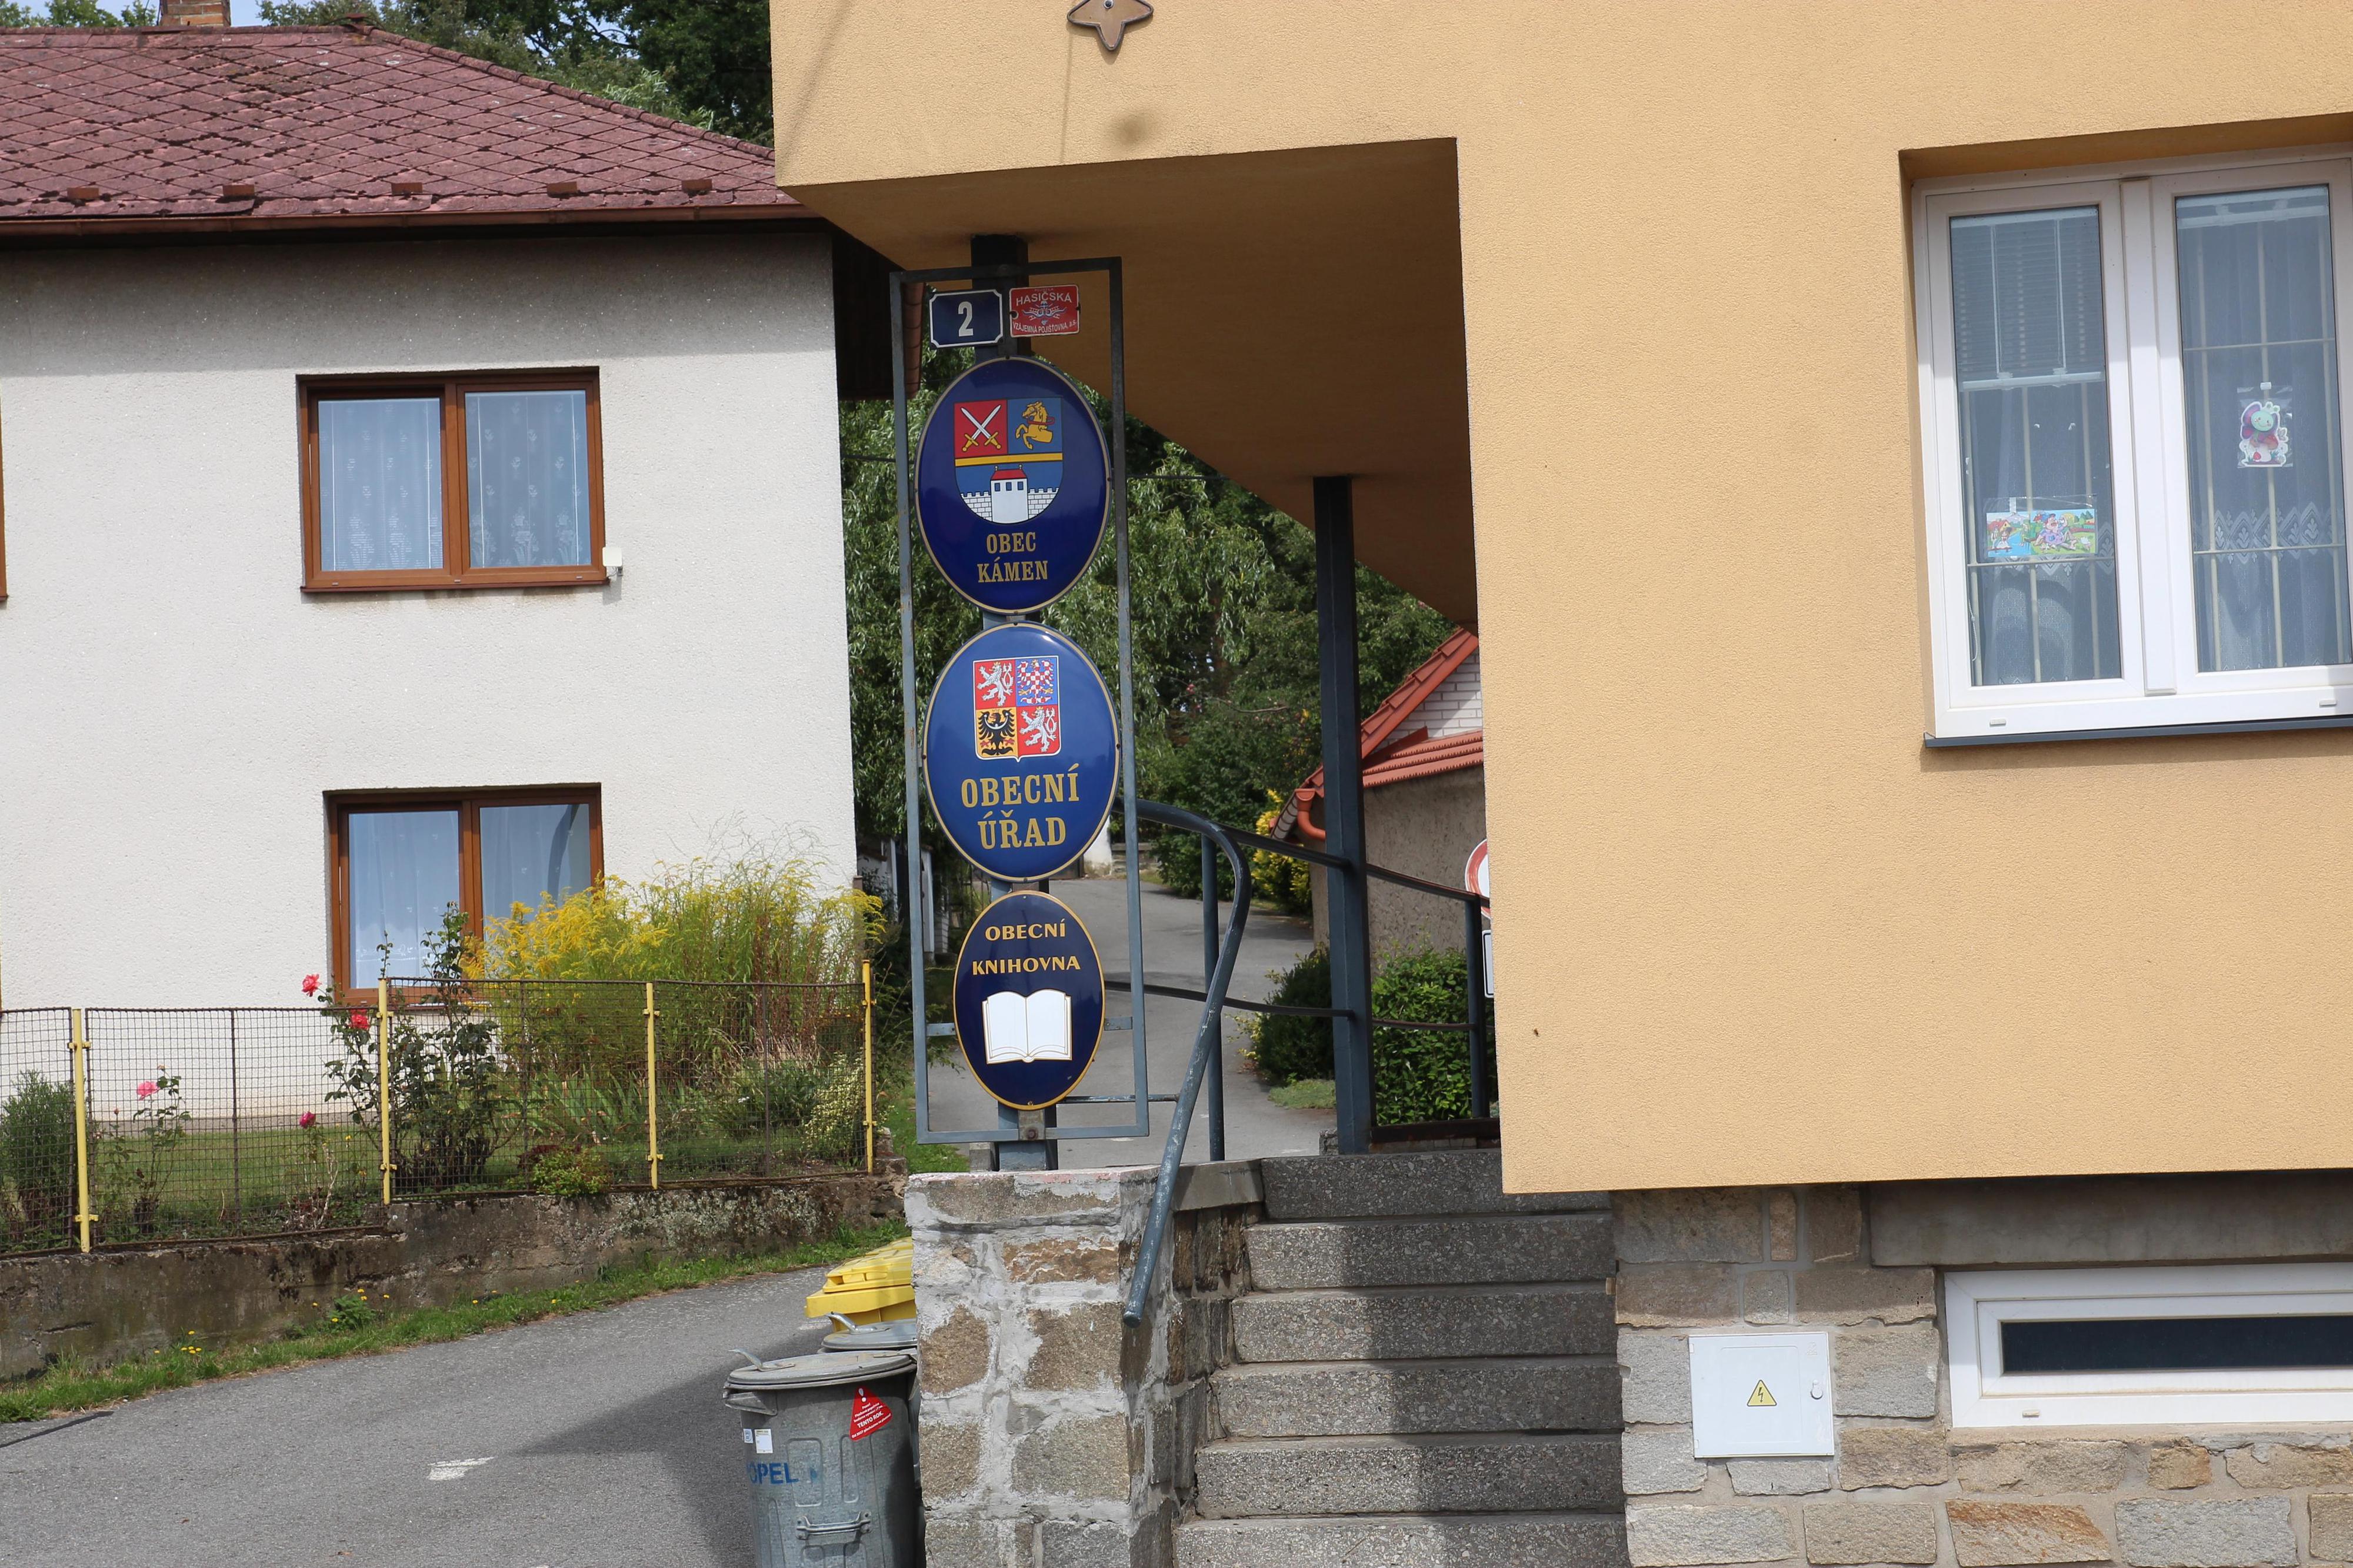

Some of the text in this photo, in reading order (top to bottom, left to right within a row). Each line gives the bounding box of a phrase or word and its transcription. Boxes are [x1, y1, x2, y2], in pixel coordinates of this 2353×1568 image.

[958, 301, 974, 337] 2
[986, 532, 1036, 554] OBEC
[977, 556, 1048, 583] KÁMEN
[961, 763, 1079, 808] OBECNÍ
[977, 809, 1066, 849] ÚŘAD
[985, 919, 1066, 941] OBECNÍ
[972, 956, 1081, 976] KNIHOVNA
